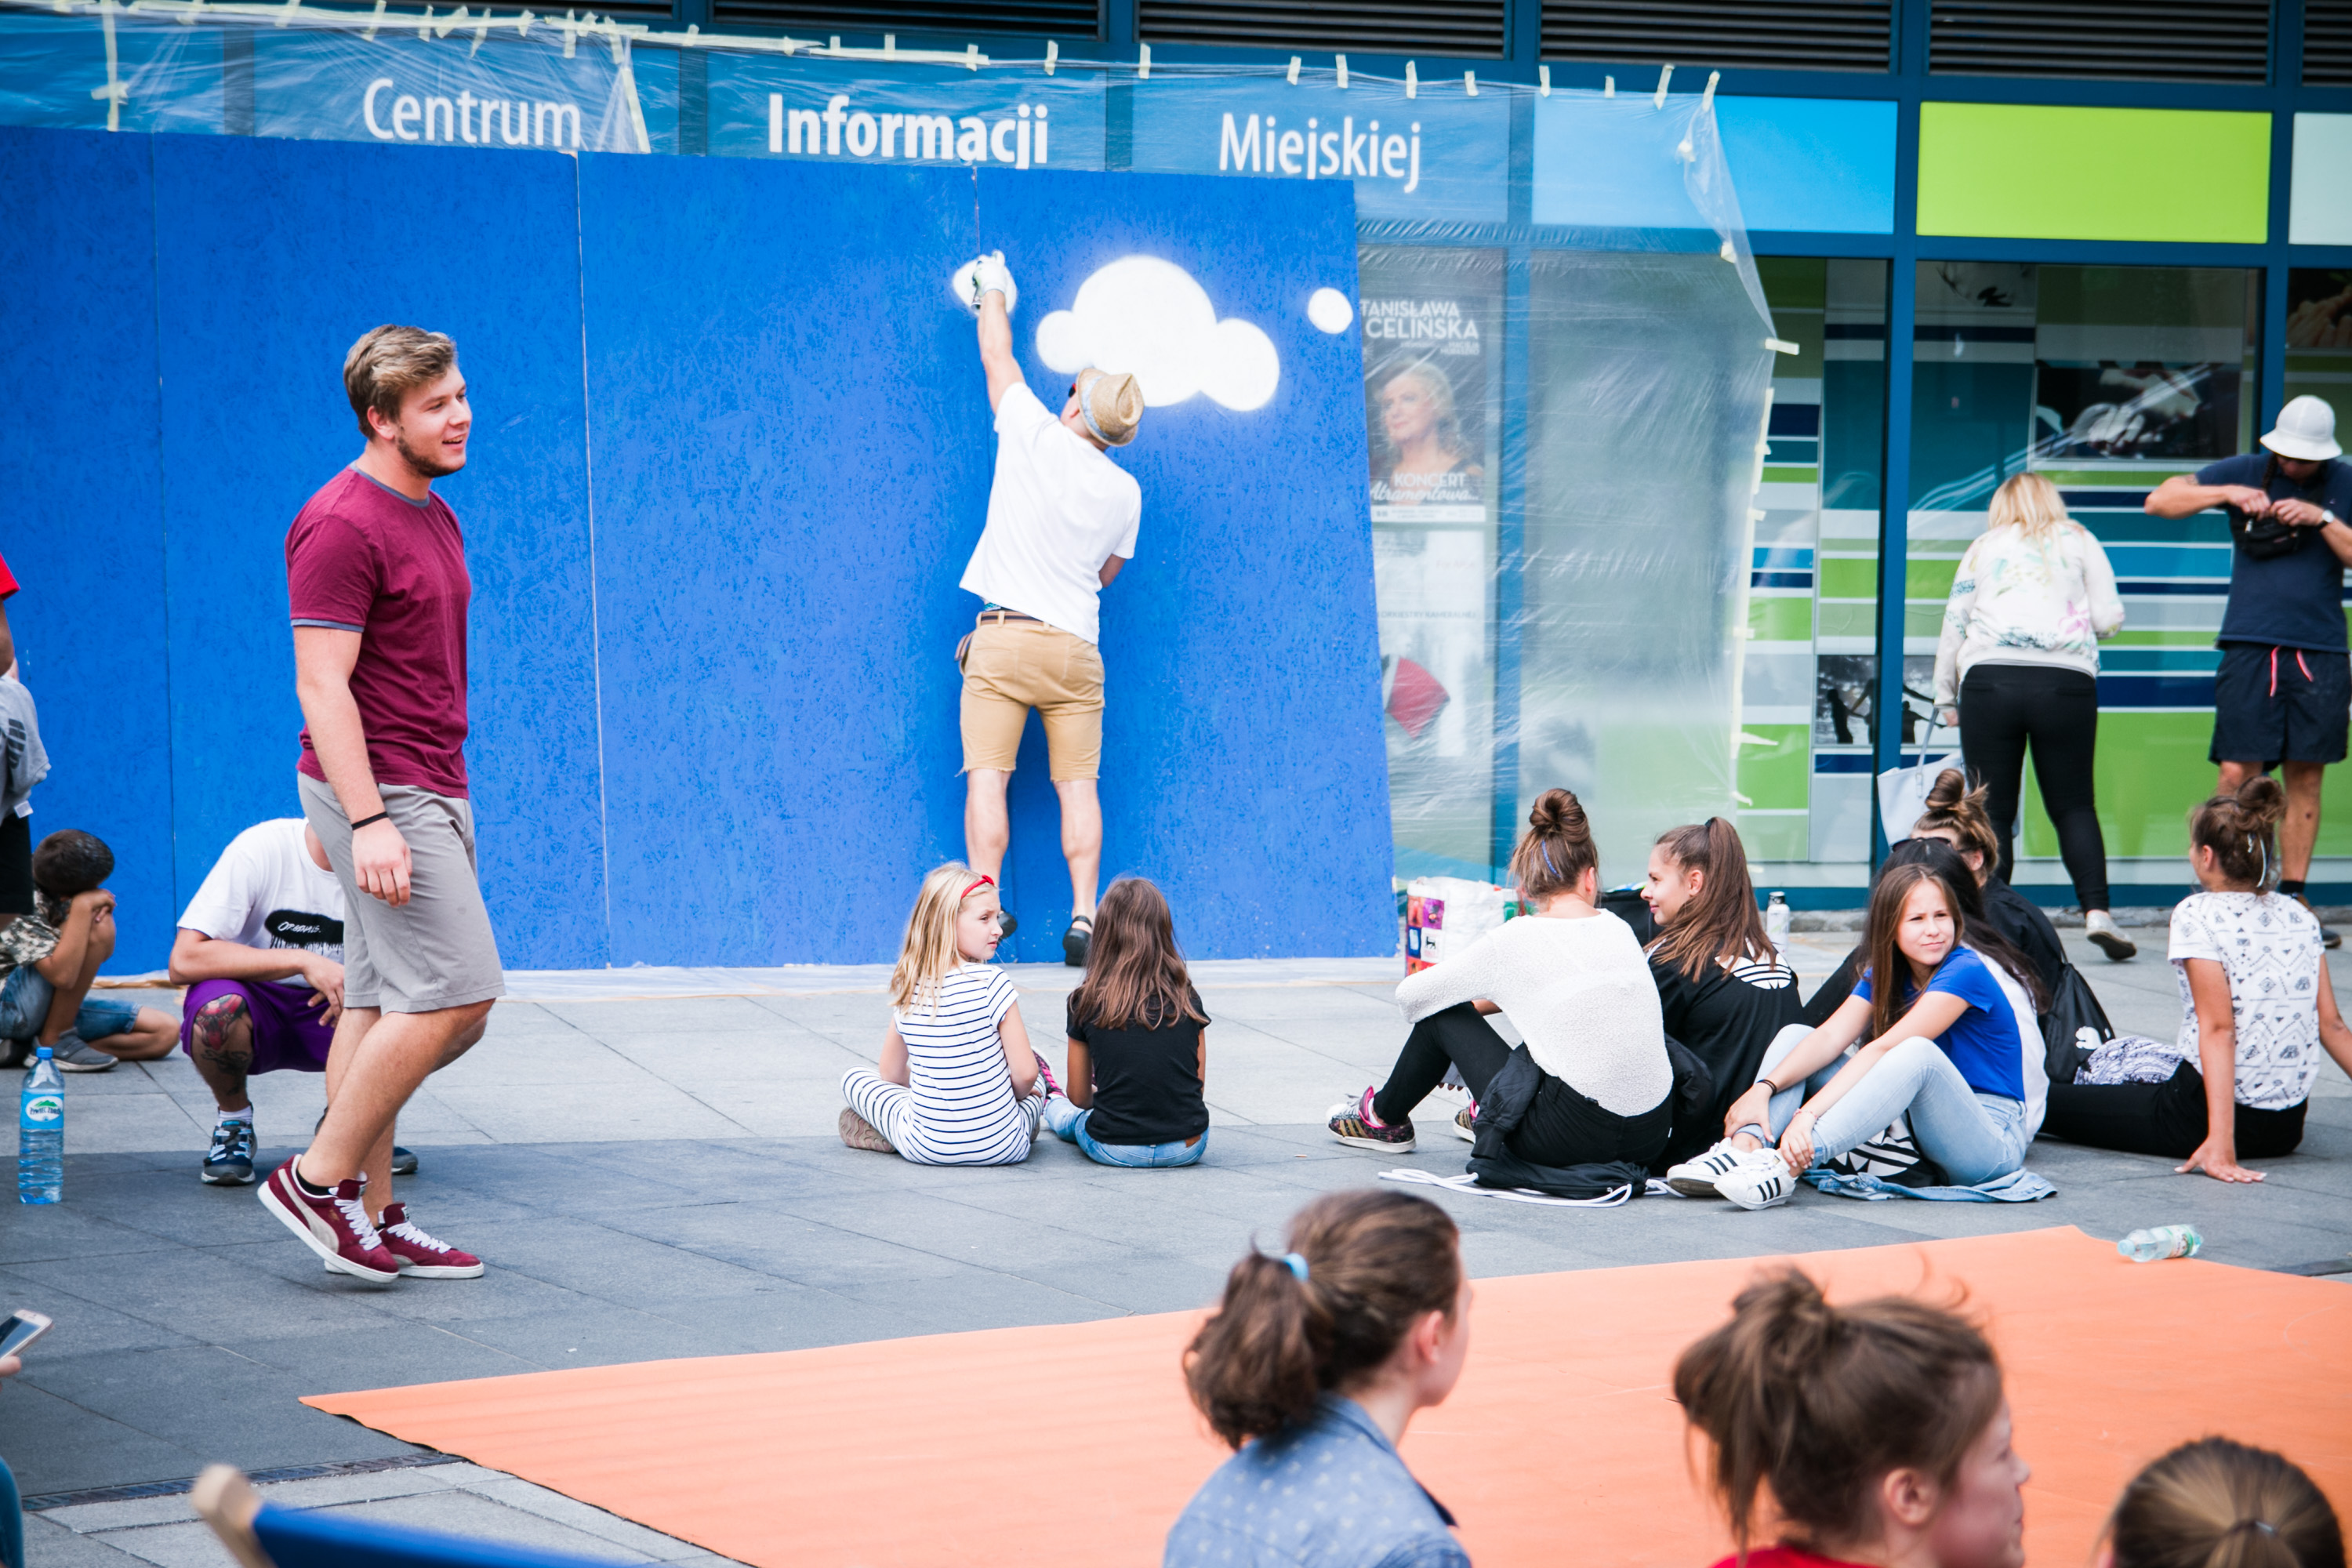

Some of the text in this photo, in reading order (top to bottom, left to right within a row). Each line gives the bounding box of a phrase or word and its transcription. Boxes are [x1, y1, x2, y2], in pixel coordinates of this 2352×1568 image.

[363, 78, 1421, 193] Centrum Informacji Miejskiej
[1360, 300, 1460, 317] TANISŁAWA
[1366, 317, 1479, 339] CELIŃSKA
[1394, 473, 1466, 488] KONCERT
